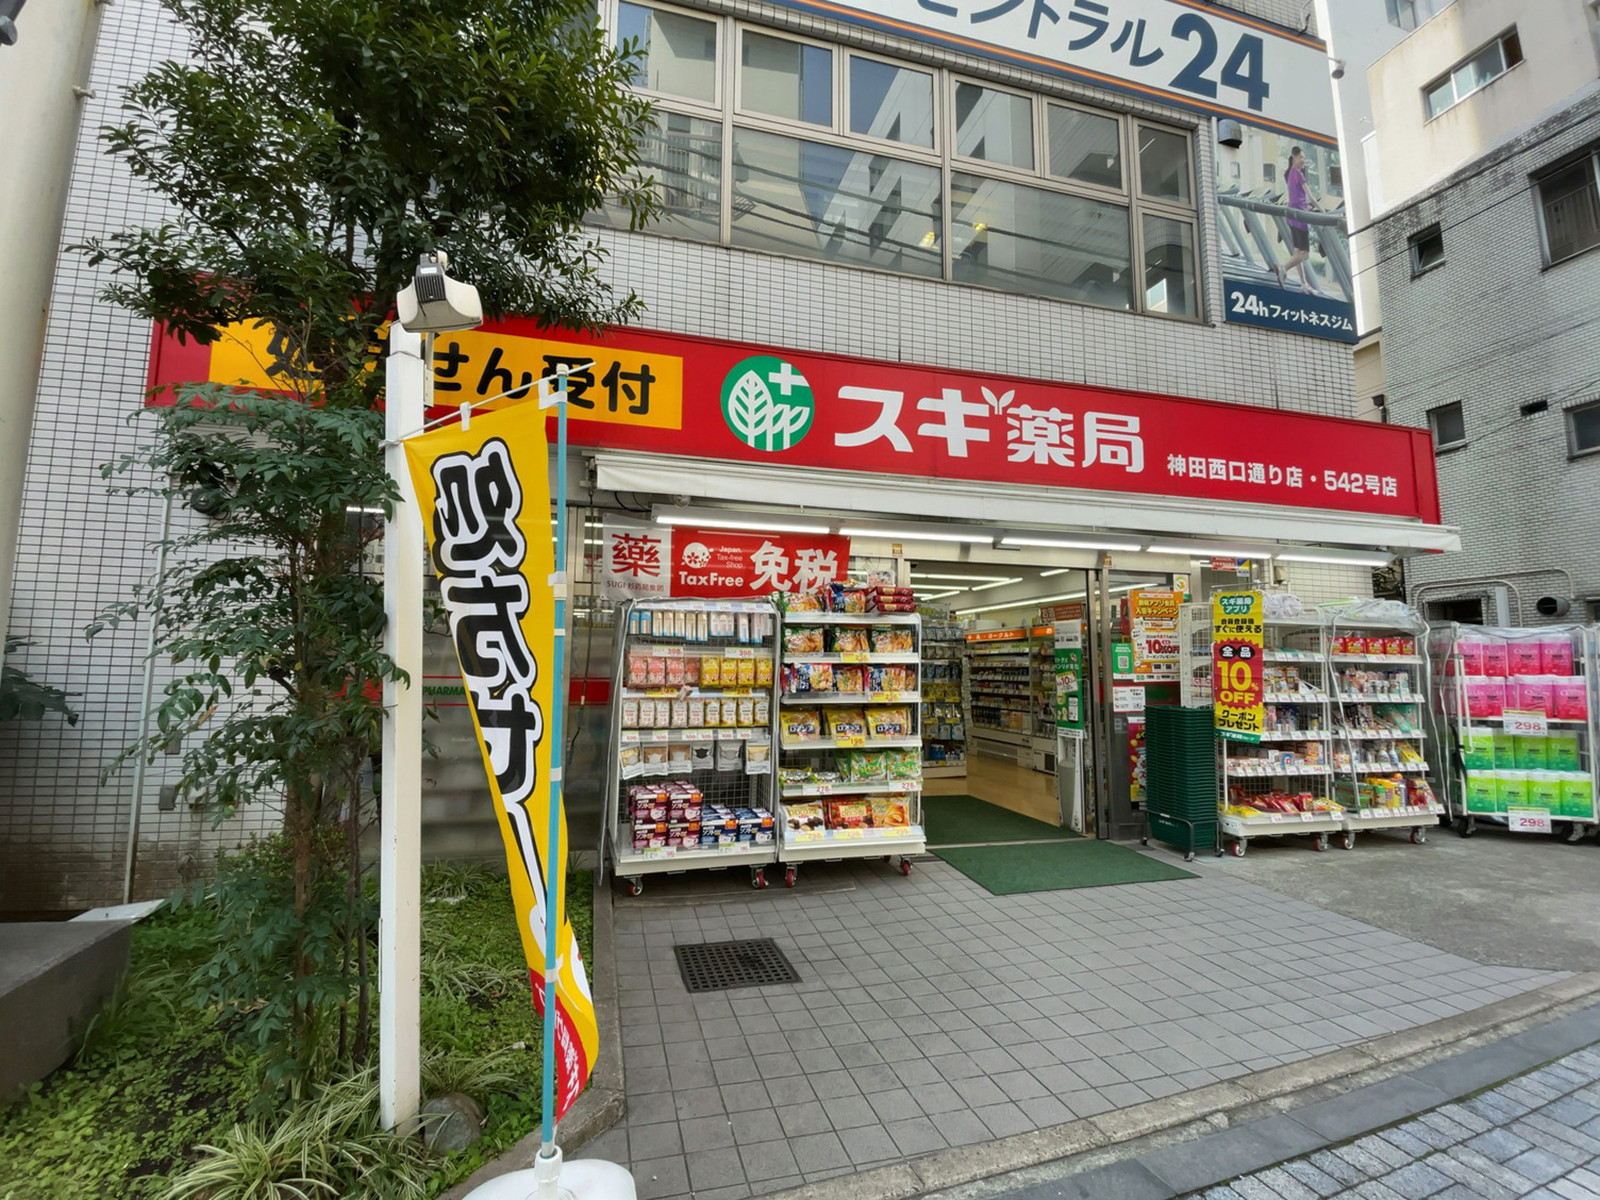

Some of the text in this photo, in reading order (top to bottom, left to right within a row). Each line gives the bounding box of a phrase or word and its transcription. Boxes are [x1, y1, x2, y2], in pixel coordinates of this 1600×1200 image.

[834, 385, 1145, 473] スギ薬局
[750, 540, 838, 594] 免税
[1222, 645, 1252, 659] 全品
[1220, 690, 1256, 704] OFF
[1222, 709, 1256, 722] クーポン
[1514, 721, 1541, 731] 298
[1520, 817, 1546, 828] 298
